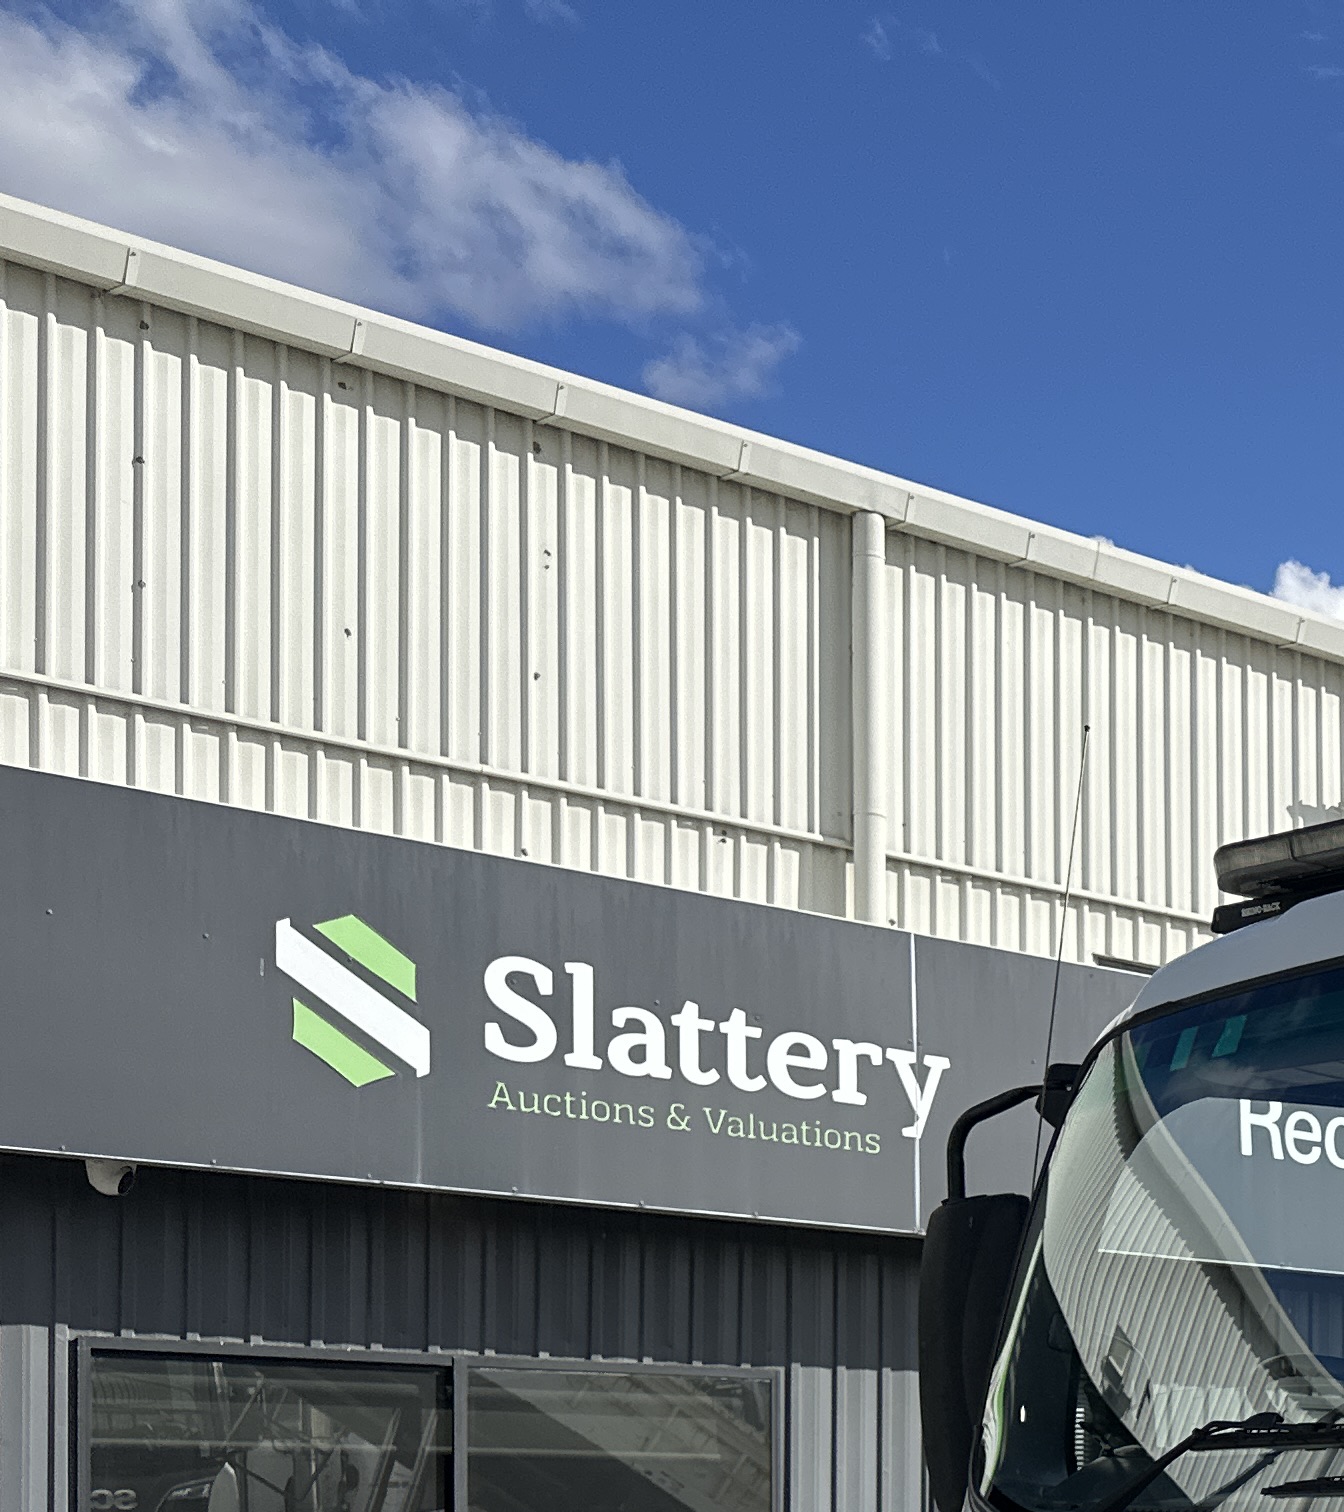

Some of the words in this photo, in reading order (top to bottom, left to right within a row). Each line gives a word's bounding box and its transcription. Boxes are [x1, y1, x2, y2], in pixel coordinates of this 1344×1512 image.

[484, 955, 951, 1139] Slattery
[487, 1081, 655, 1129] Auctions
[666, 1103, 692, 1132] &
[703, 1106, 882, 1154] Valuations
